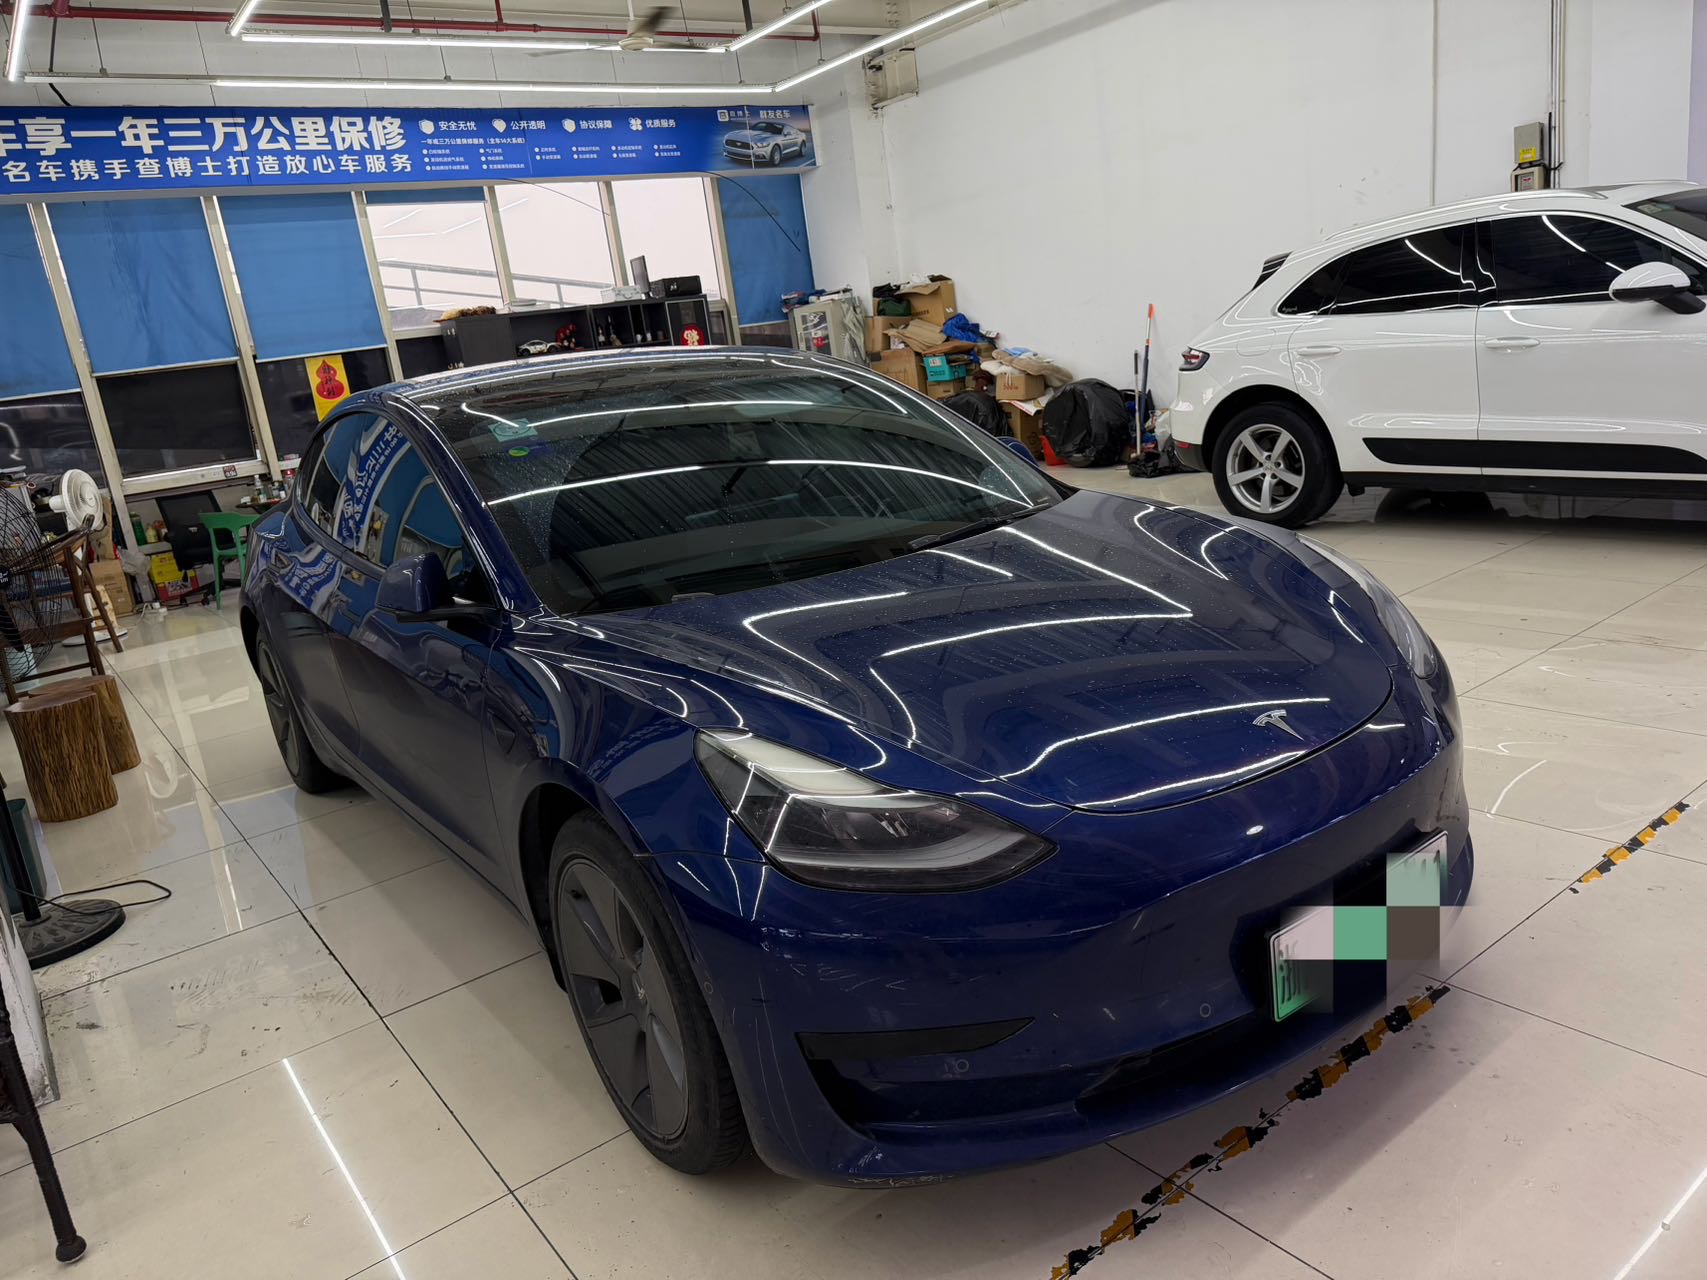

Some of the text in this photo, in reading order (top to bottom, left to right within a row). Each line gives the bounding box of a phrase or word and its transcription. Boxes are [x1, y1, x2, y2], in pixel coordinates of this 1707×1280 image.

[438, 120, 477, 131] 安全无忧
[510, 119, 546, 130] 公开透明
[579, 119, 613, 129] 协议保障
[645, 118, 676, 128] 优质服务
[2, 153, 413, 183] 名车携手查博士打造放心车服务
